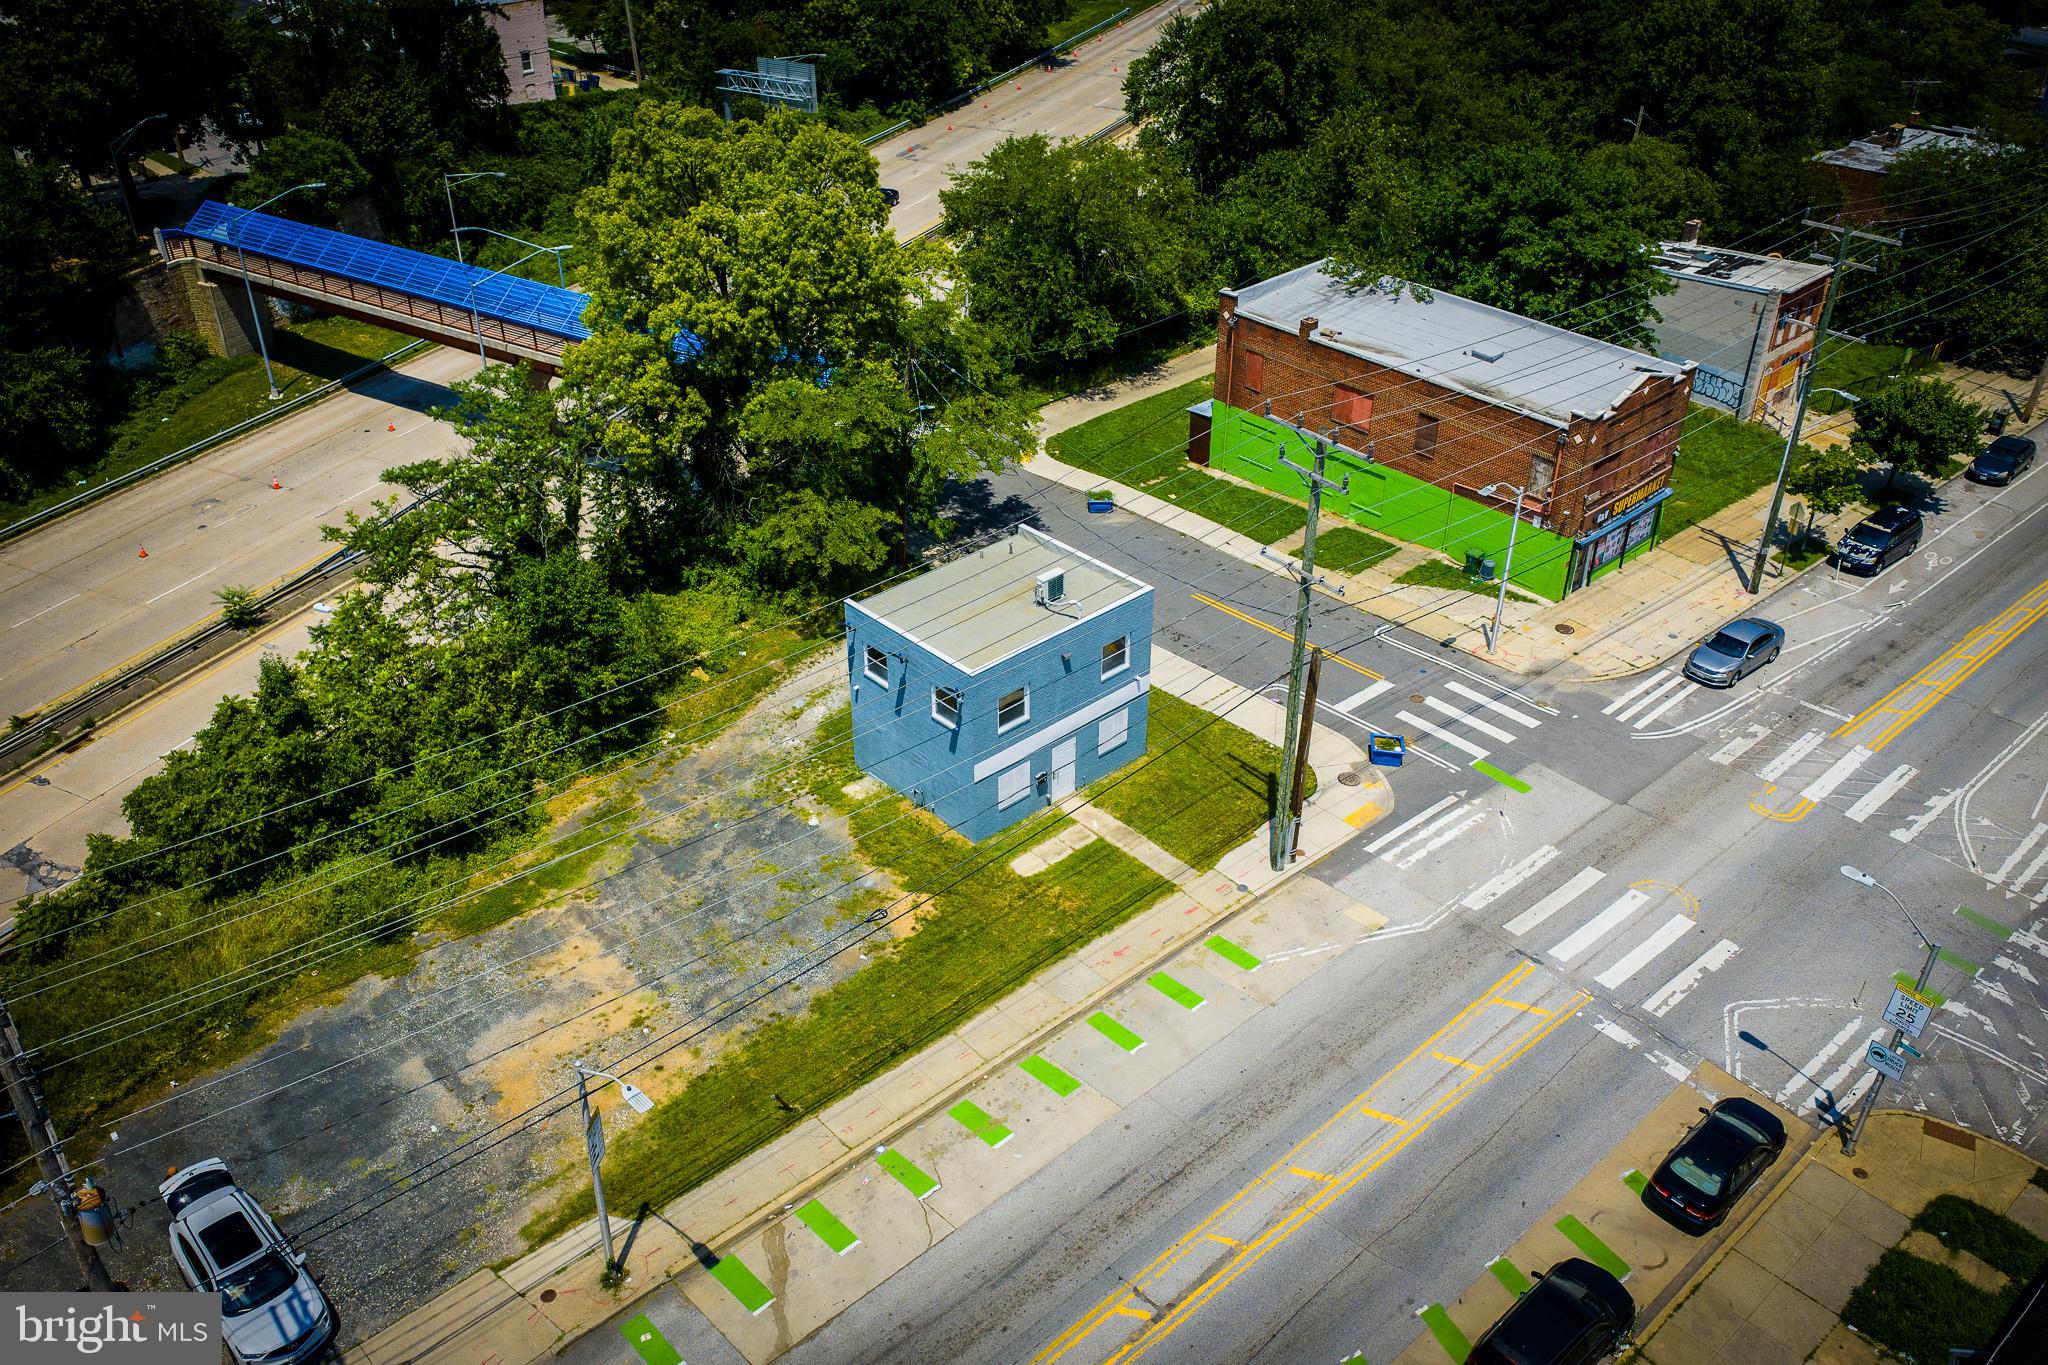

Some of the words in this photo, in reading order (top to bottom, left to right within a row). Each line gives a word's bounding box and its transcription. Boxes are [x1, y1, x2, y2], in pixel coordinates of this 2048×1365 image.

[1612, 475, 1666, 516] SUPERMARKET
[1899, 986, 1917, 1000] SCHOOL
[1919, 995, 1932, 1007] ZONE
[1900, 994, 1924, 1011] SPEED
[1895, 1008, 1916, 1024] 25
[1900, 1002, 1919, 1015] LIMIT
[1885, 1062, 1901, 1073] ROUTE
[1886, 1057, 1903, 1069] TRUCK
